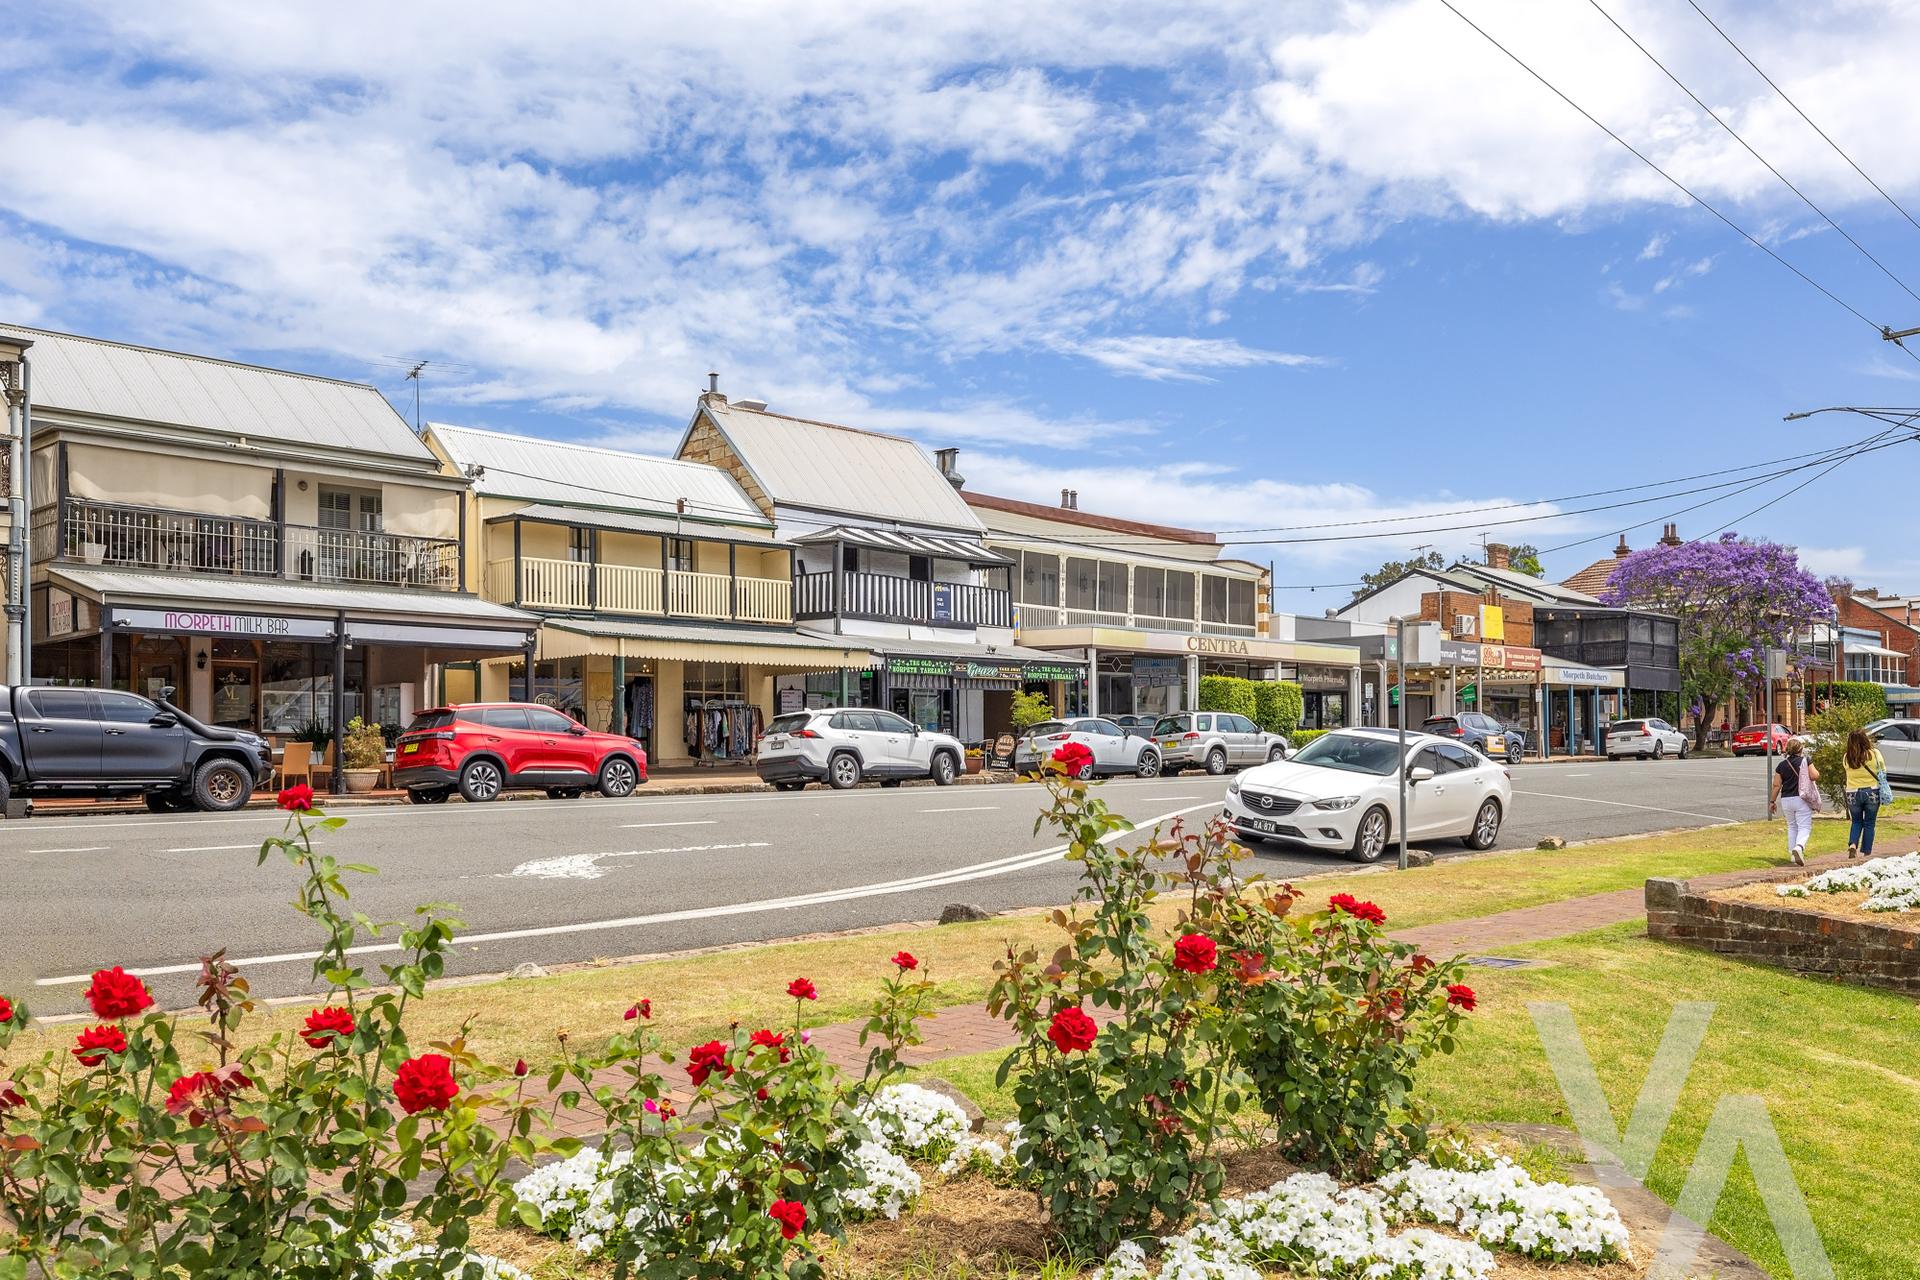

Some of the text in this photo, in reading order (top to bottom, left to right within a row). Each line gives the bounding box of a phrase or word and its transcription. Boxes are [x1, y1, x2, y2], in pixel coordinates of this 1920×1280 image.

[52, 600, 71, 616] MORPETH
[165, 612, 288, 634] MORPETH MILK BAR
[1187, 636, 1248, 654] CENTRA
[1462, 648, 1476, 656] Morpeth
[1461, 656, 1477, 664] Pharmacy
[968, 662, 998, 678] Graze
[1563, 670, 1608, 682] Morpeth Butchery
[1303, 674, 1345, 685] Morpeth Pharmacy
[1254, 820, 1262, 829] RA
